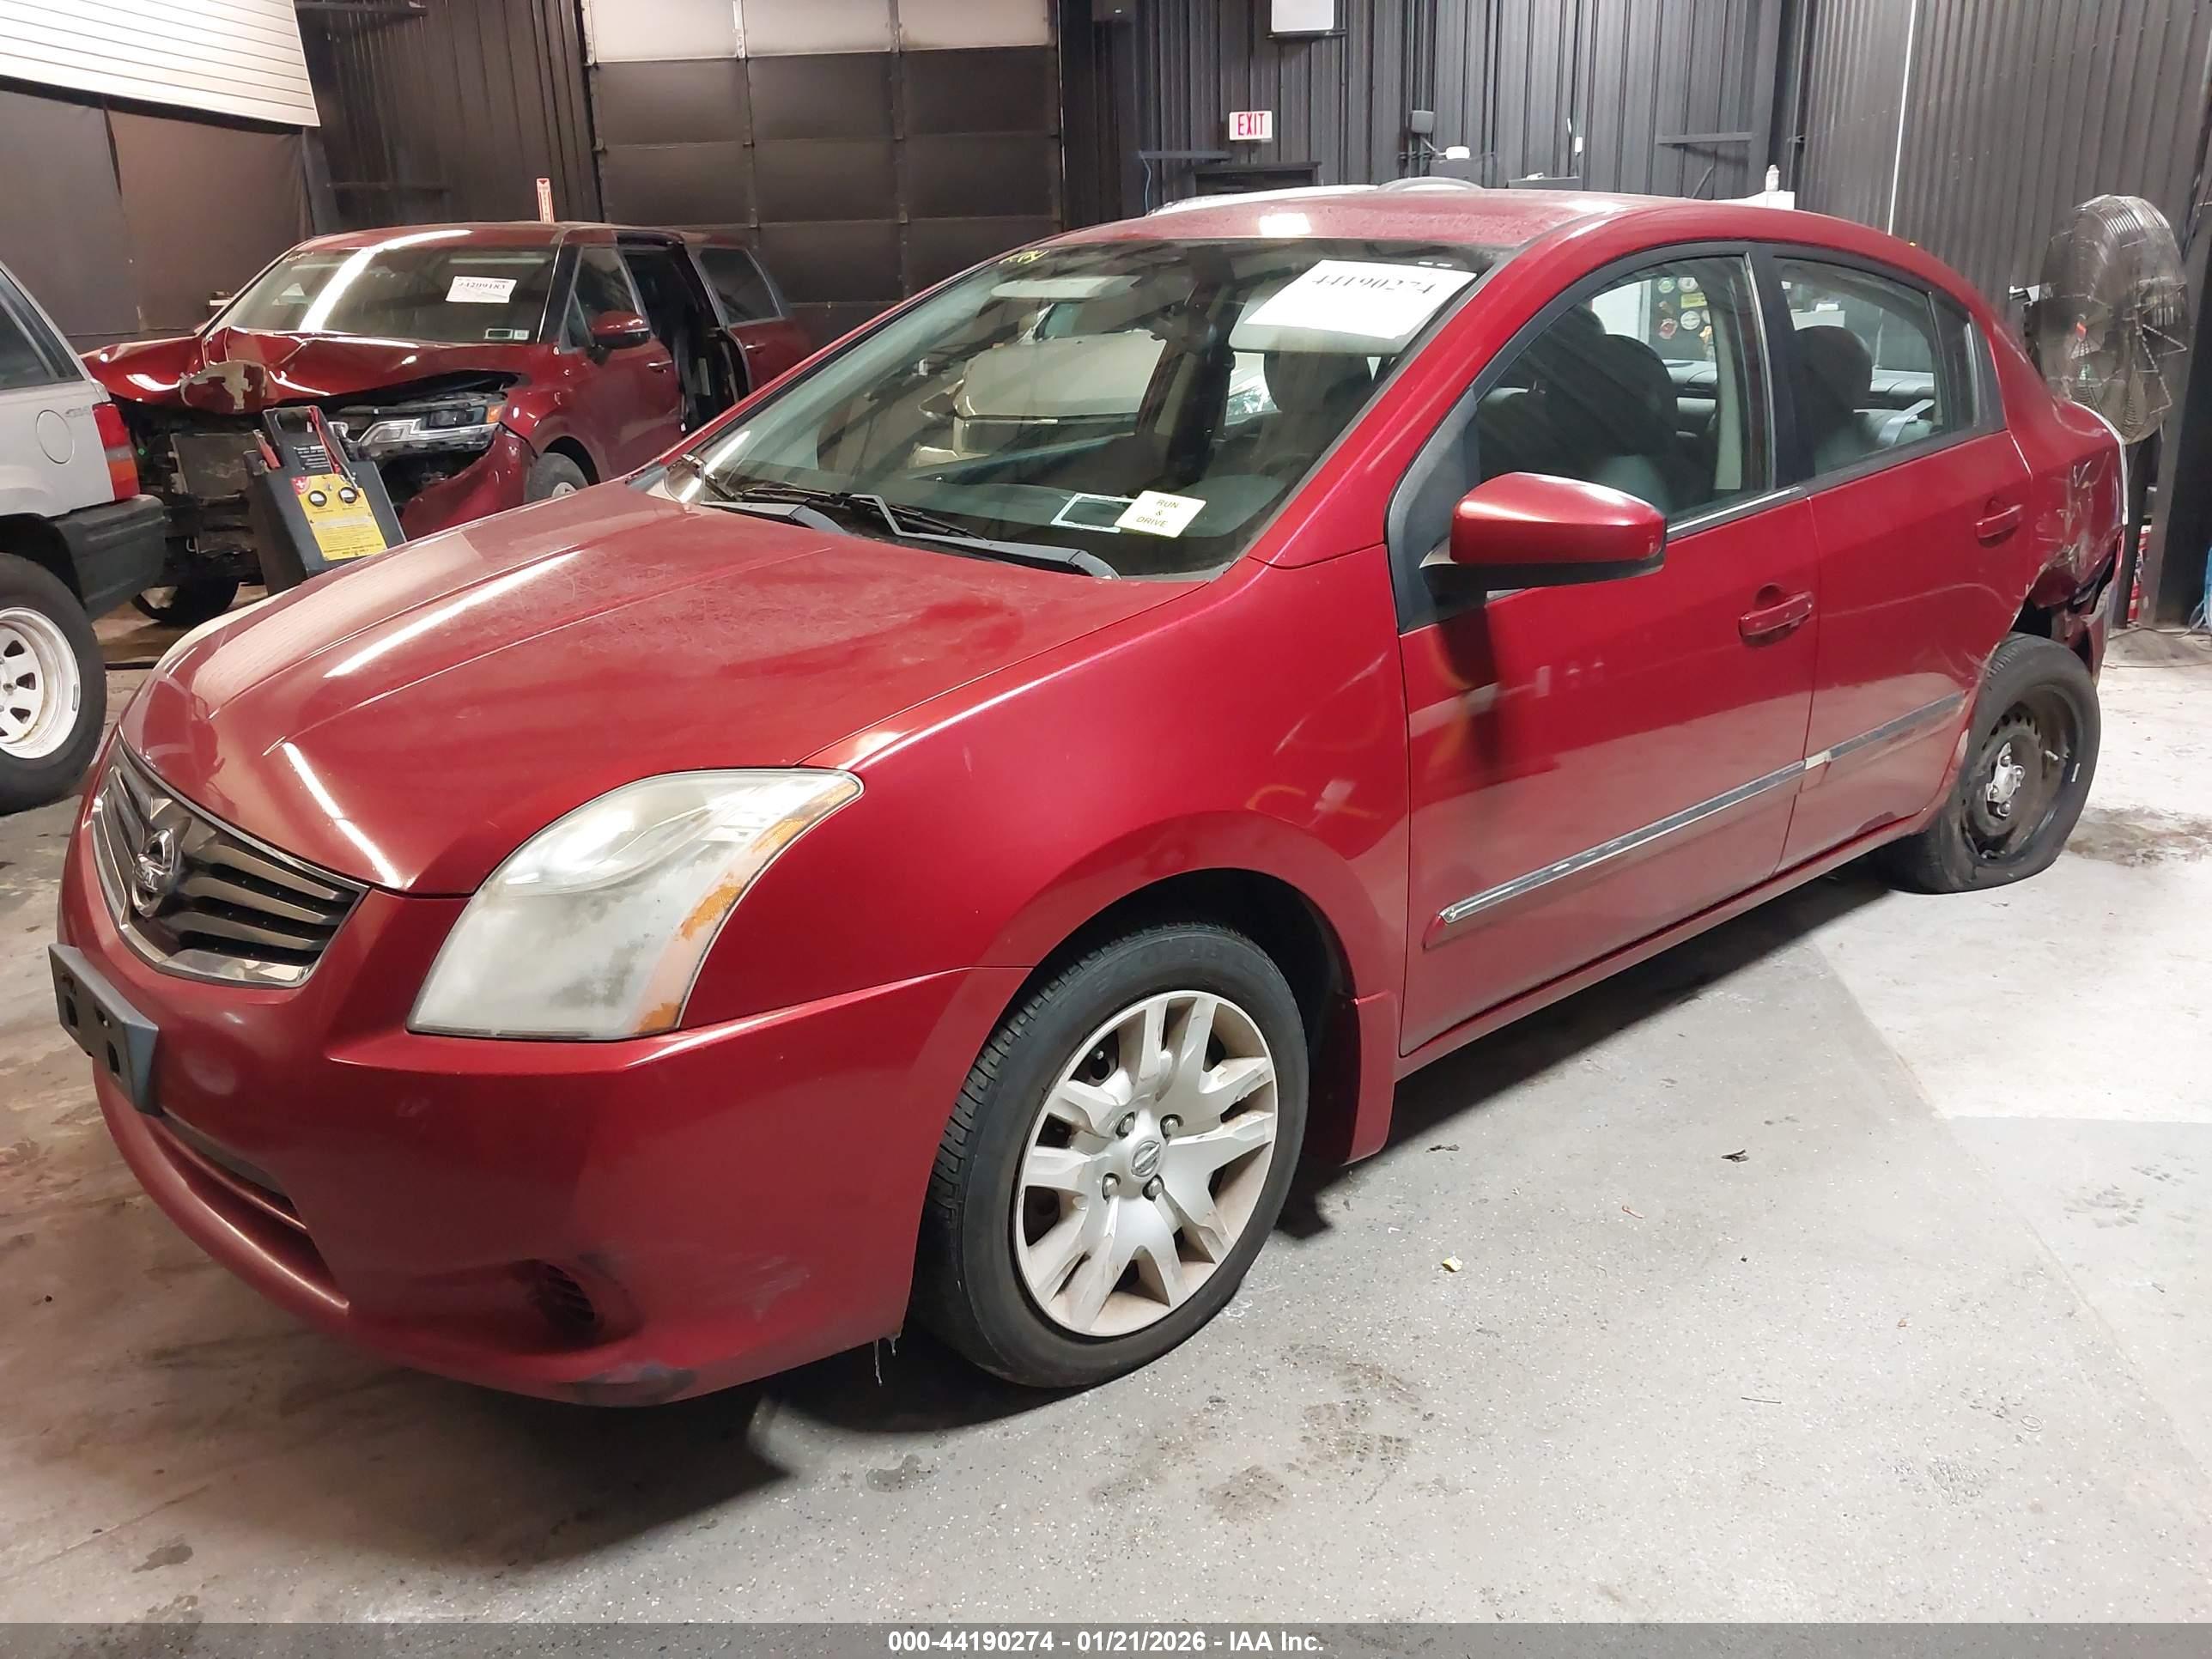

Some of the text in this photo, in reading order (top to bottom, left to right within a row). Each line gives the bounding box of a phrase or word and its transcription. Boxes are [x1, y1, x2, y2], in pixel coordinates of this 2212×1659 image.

[1238, 112, 1265, 136] EXIT
[1157, 499, 1179, 508] RUN
[1135, 515, 1168, 527] DRIVE
